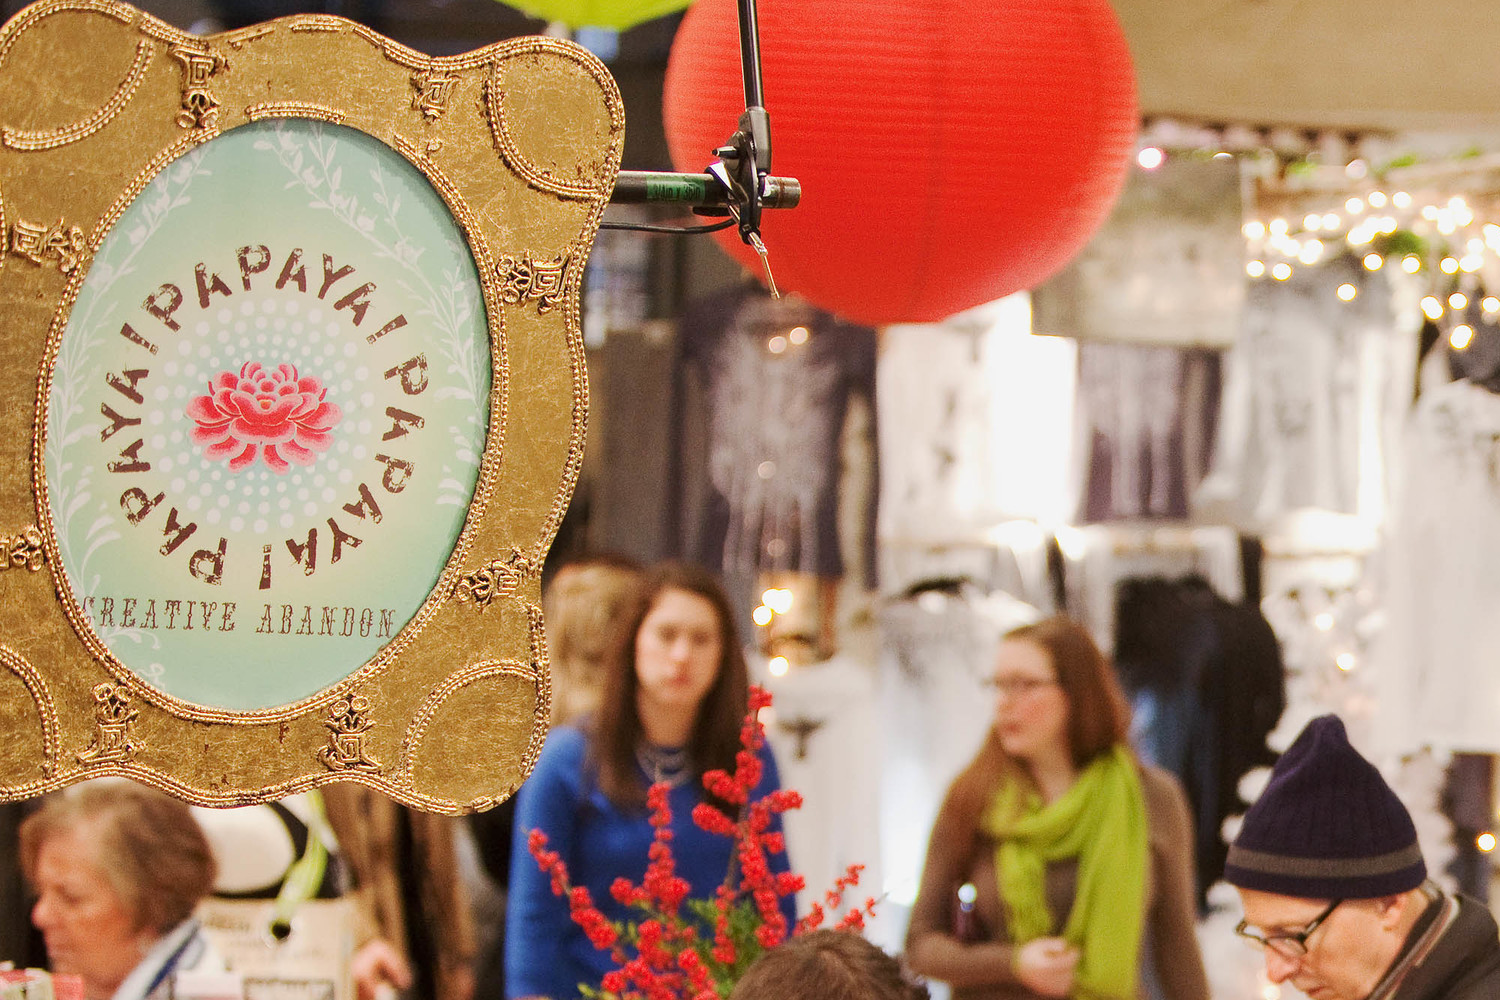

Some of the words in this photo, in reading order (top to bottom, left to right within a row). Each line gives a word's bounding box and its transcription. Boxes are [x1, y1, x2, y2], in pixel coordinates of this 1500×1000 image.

[141, 244, 408, 345] PAPAYA!
[100, 322, 228, 586] PAPAYA!
[258, 352, 429, 590] PAPAYA!
[256, 603, 396, 639] ABANDON
